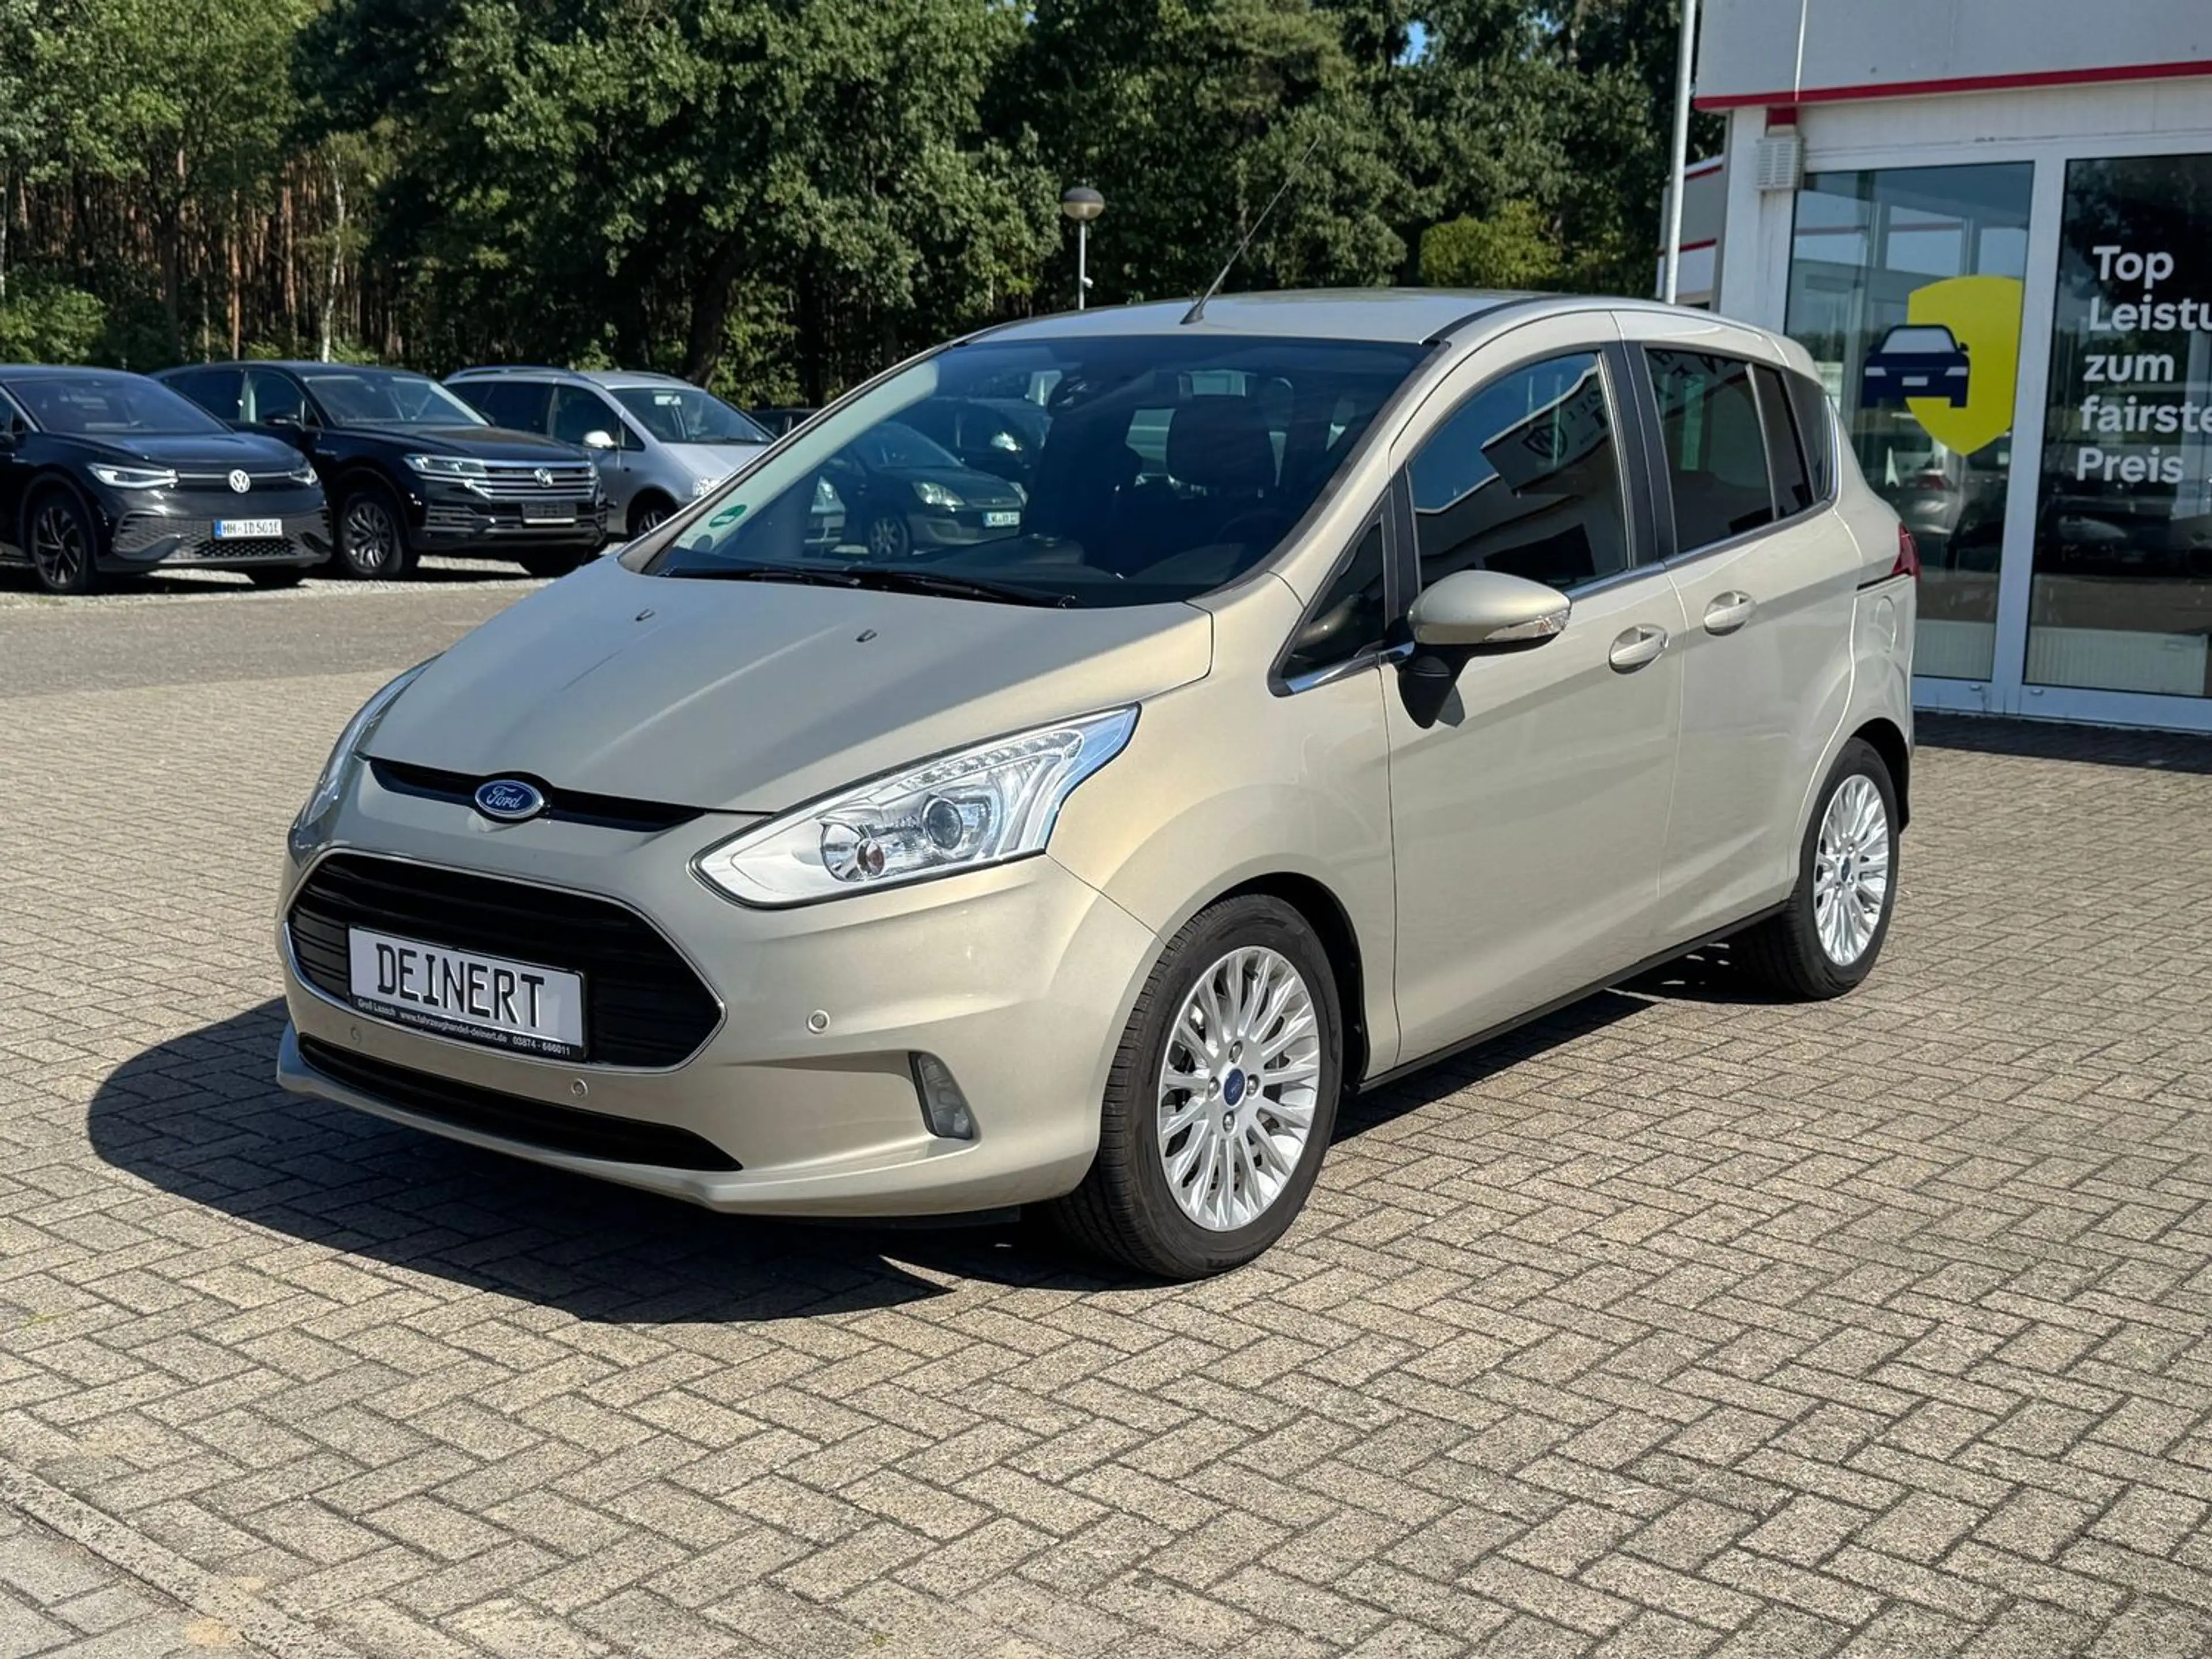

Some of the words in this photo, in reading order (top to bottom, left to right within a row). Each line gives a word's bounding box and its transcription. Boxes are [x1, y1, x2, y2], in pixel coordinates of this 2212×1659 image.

[2092, 245, 2175, 289] Top
[2082, 354, 2175, 382] zum
[2076, 446, 2184, 483] Preis
[486, 786, 524, 809] Ford
[376, 942, 545, 1028] DEINERT
